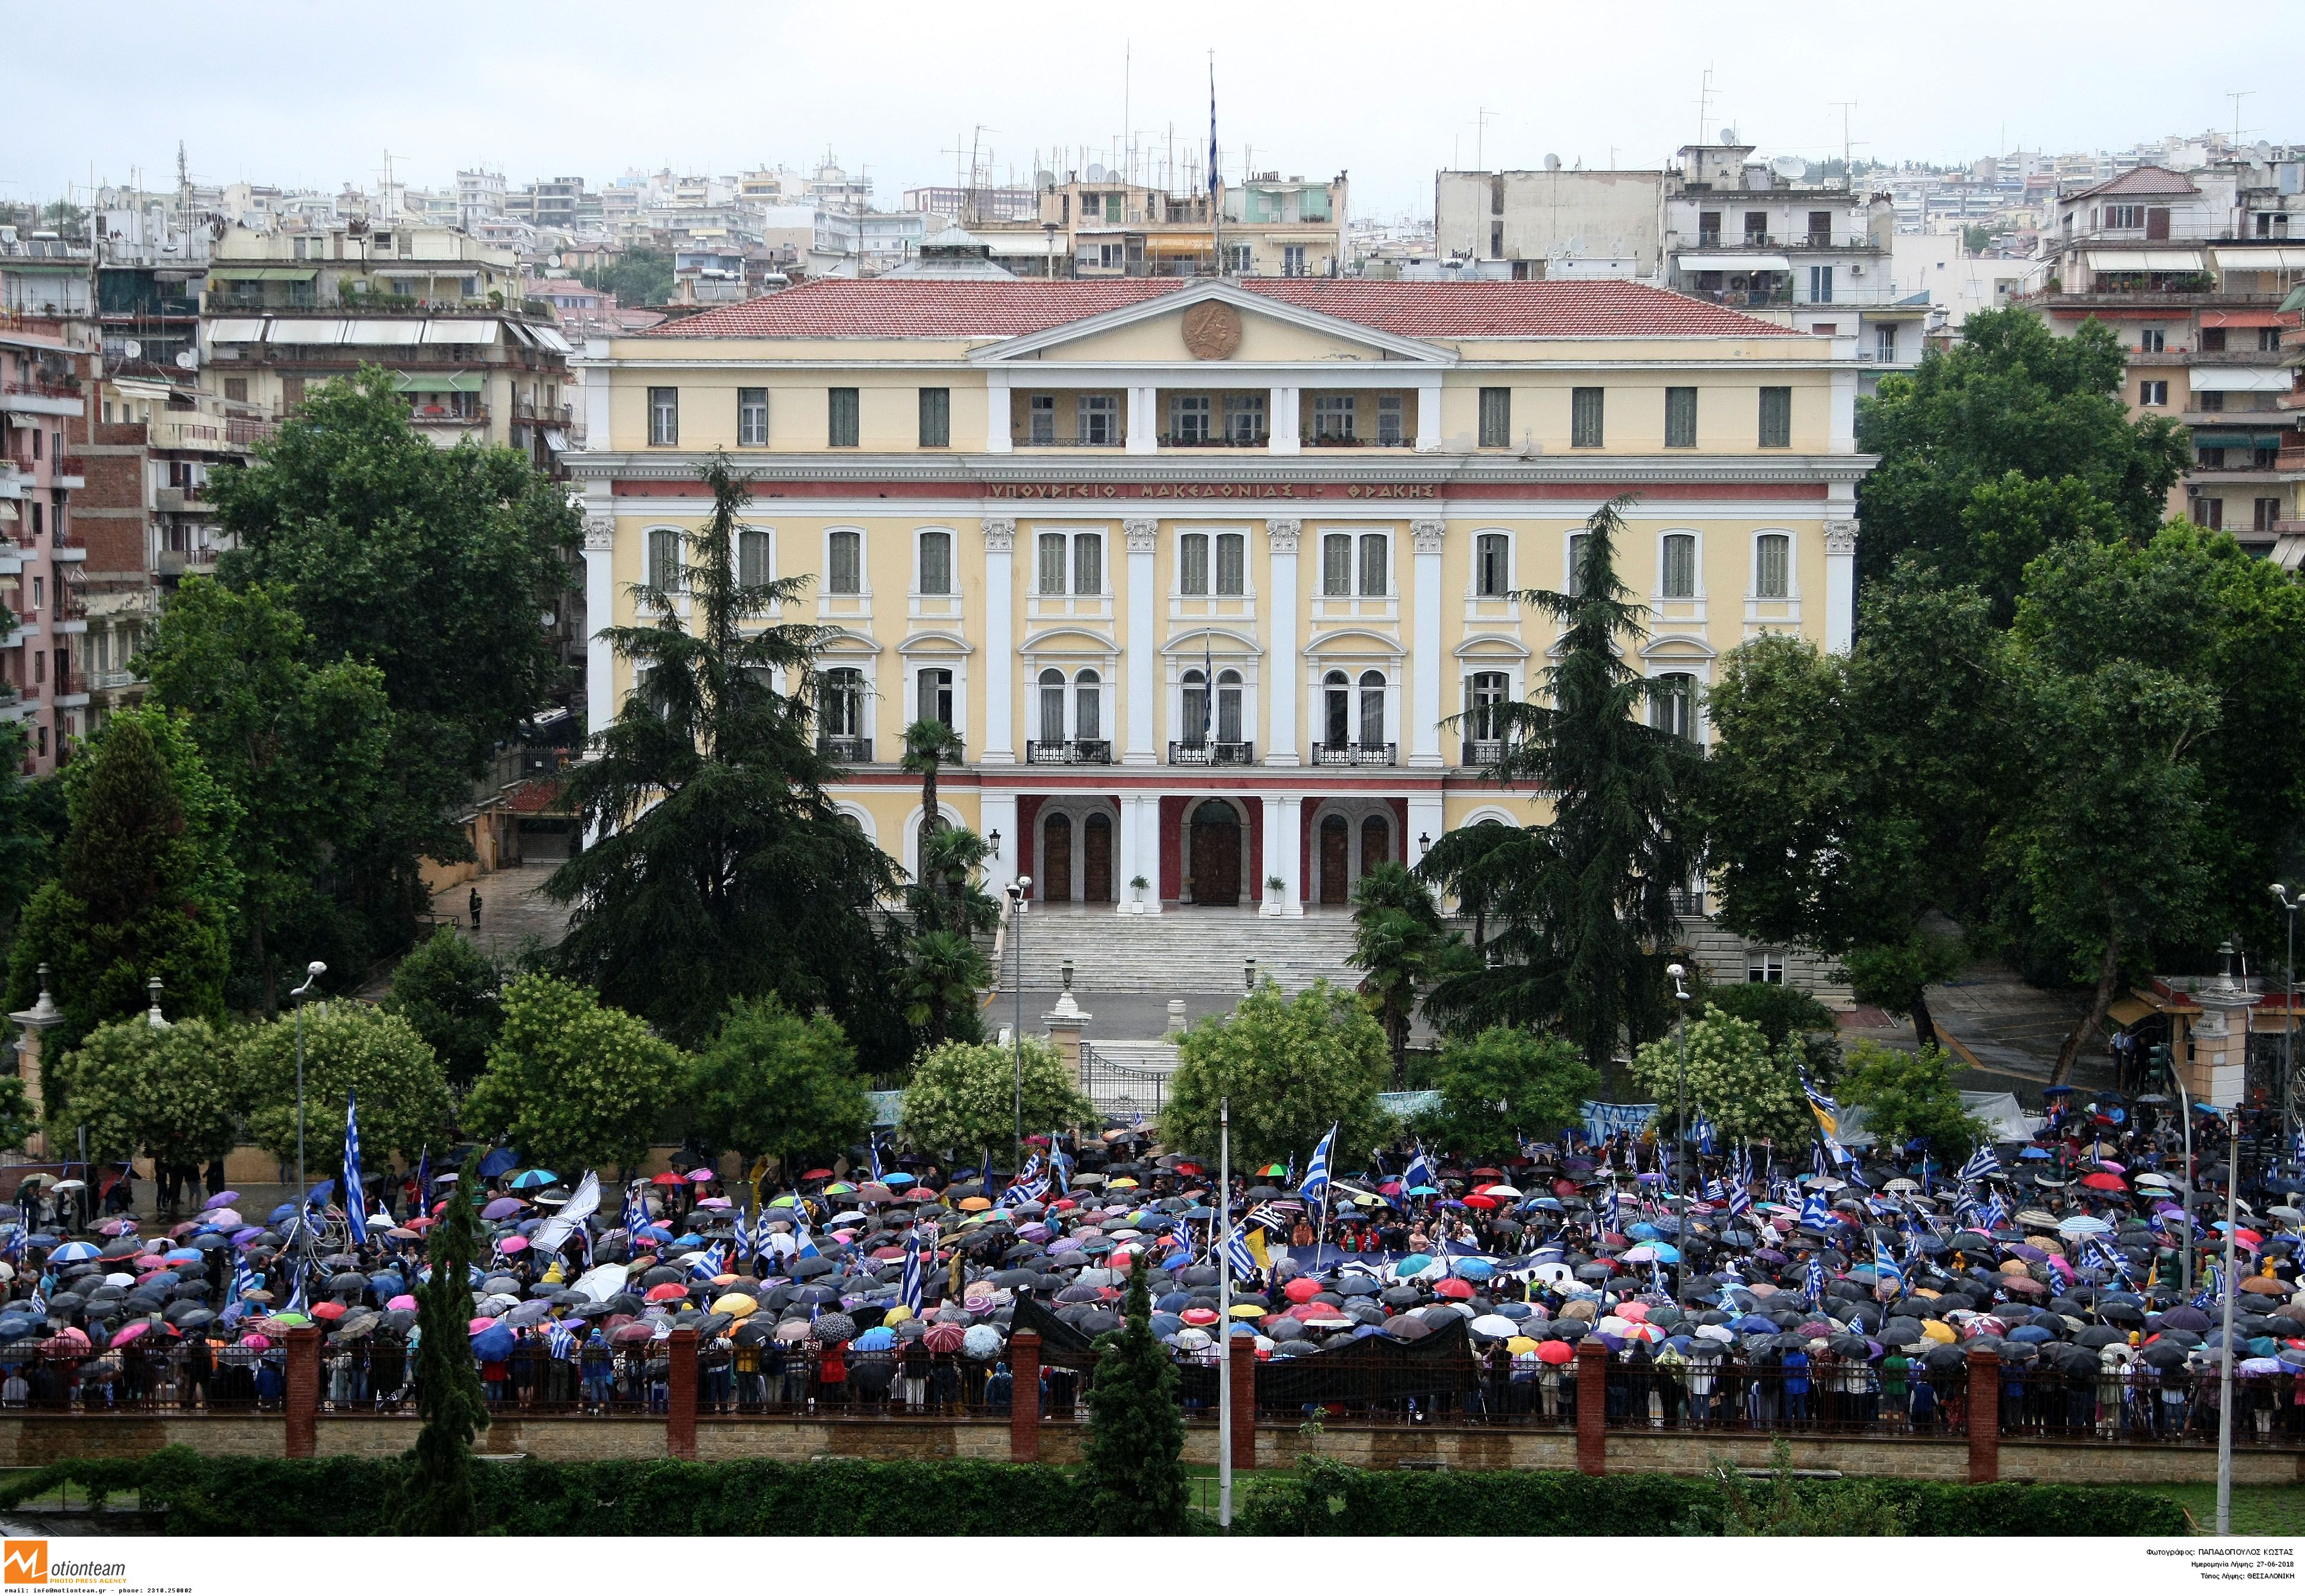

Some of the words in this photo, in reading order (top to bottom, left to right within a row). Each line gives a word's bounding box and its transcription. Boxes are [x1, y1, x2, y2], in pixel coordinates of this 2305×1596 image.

[991, 483, 1117, 498] ΥΠΟΥΡΓΕΙΟ
[1141, 483, 1294, 498] ΜΑΚΕΔΟΝΙΑΣ
[1346, 483, 1435, 499] ΘΡΑΚΗΣ
